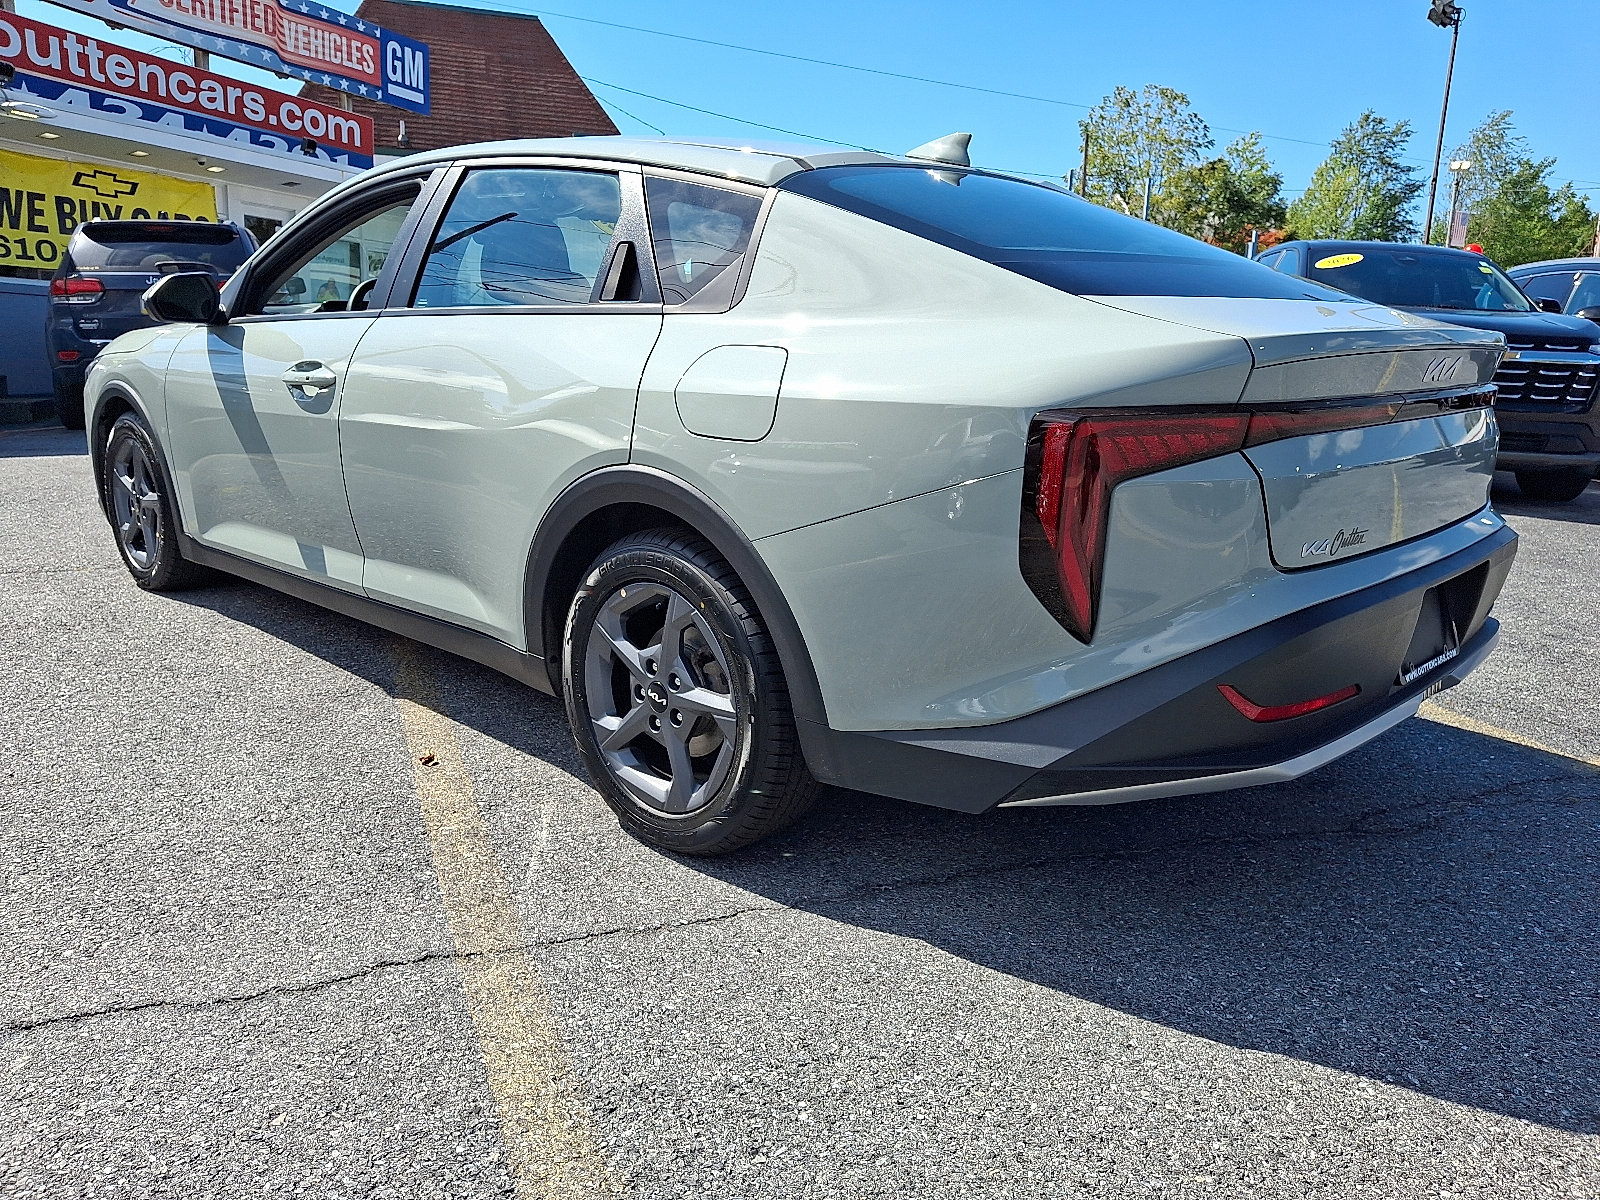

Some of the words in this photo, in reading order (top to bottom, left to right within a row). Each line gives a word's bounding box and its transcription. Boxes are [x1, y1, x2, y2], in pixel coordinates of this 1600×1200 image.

[283, 18, 374, 75] VEHICLES
[386, 40, 424, 91] GM
[0, 19, 361, 147] outtencars.com
[1301, 538, 1330, 558] K4
[1330, 527, 1370, 556] Outten
